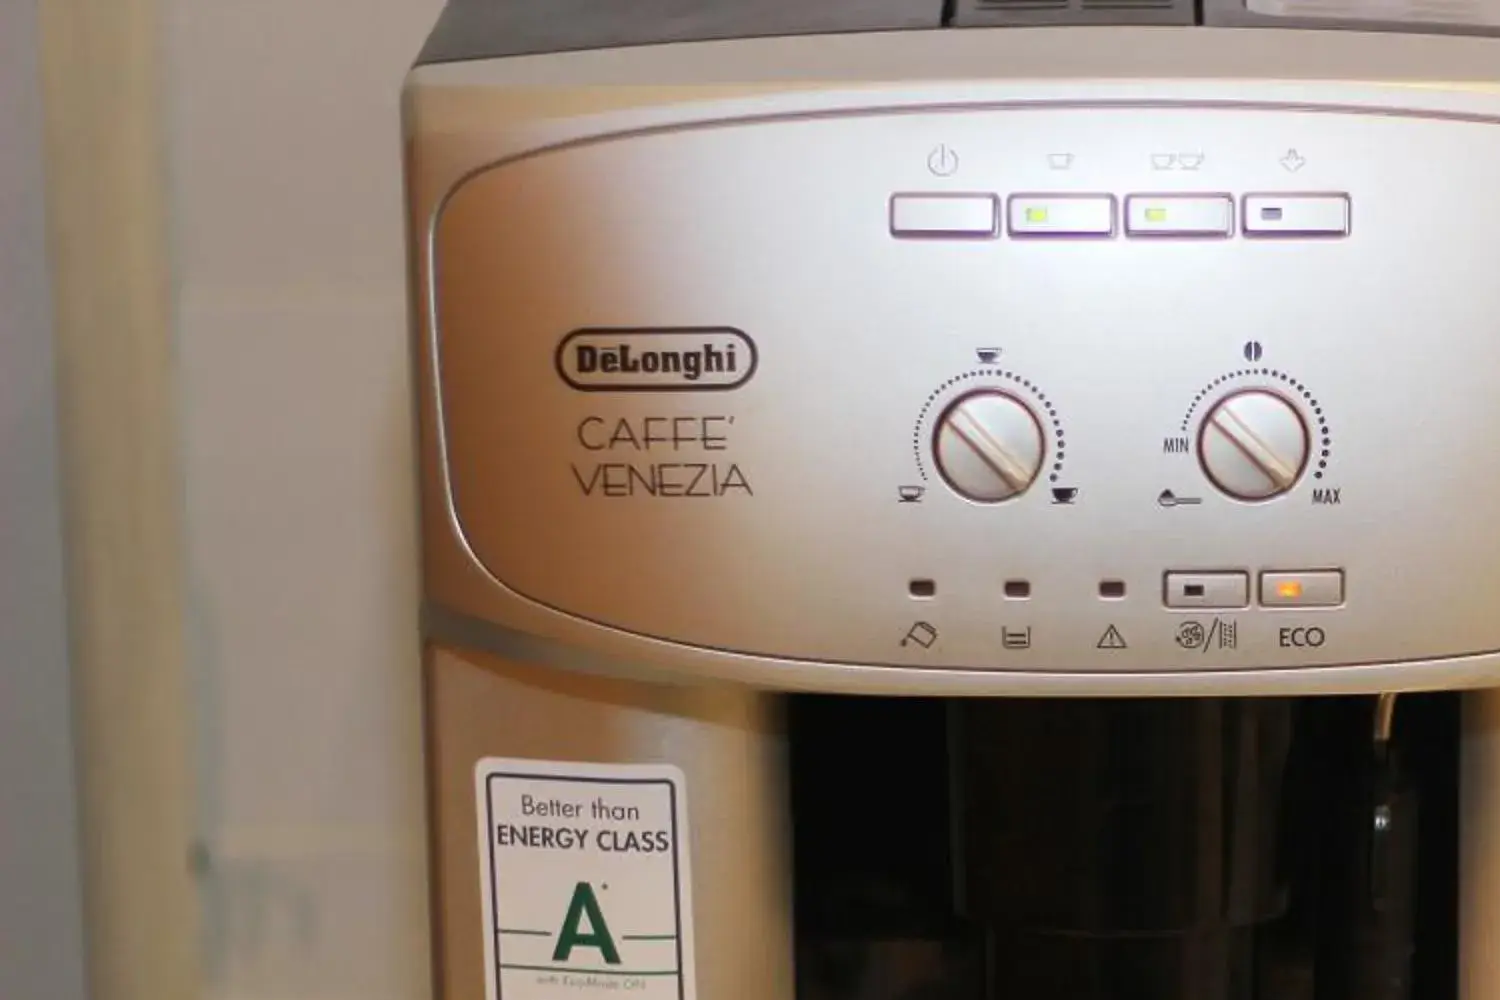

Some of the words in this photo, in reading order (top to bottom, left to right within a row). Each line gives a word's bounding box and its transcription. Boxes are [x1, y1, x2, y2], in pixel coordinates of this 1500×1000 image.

[1163, 437, 1189, 454] MIN
[571, 463, 754, 497] VENEZIA
[1312, 487, 1341, 506] MAX
[1278, 627, 1326, 648] ECO
[521, 794, 583, 819] Better
[591, 797, 640, 821] than
[497, 825, 589, 850] ENERGY
[596, 830, 670, 853] CLASS
